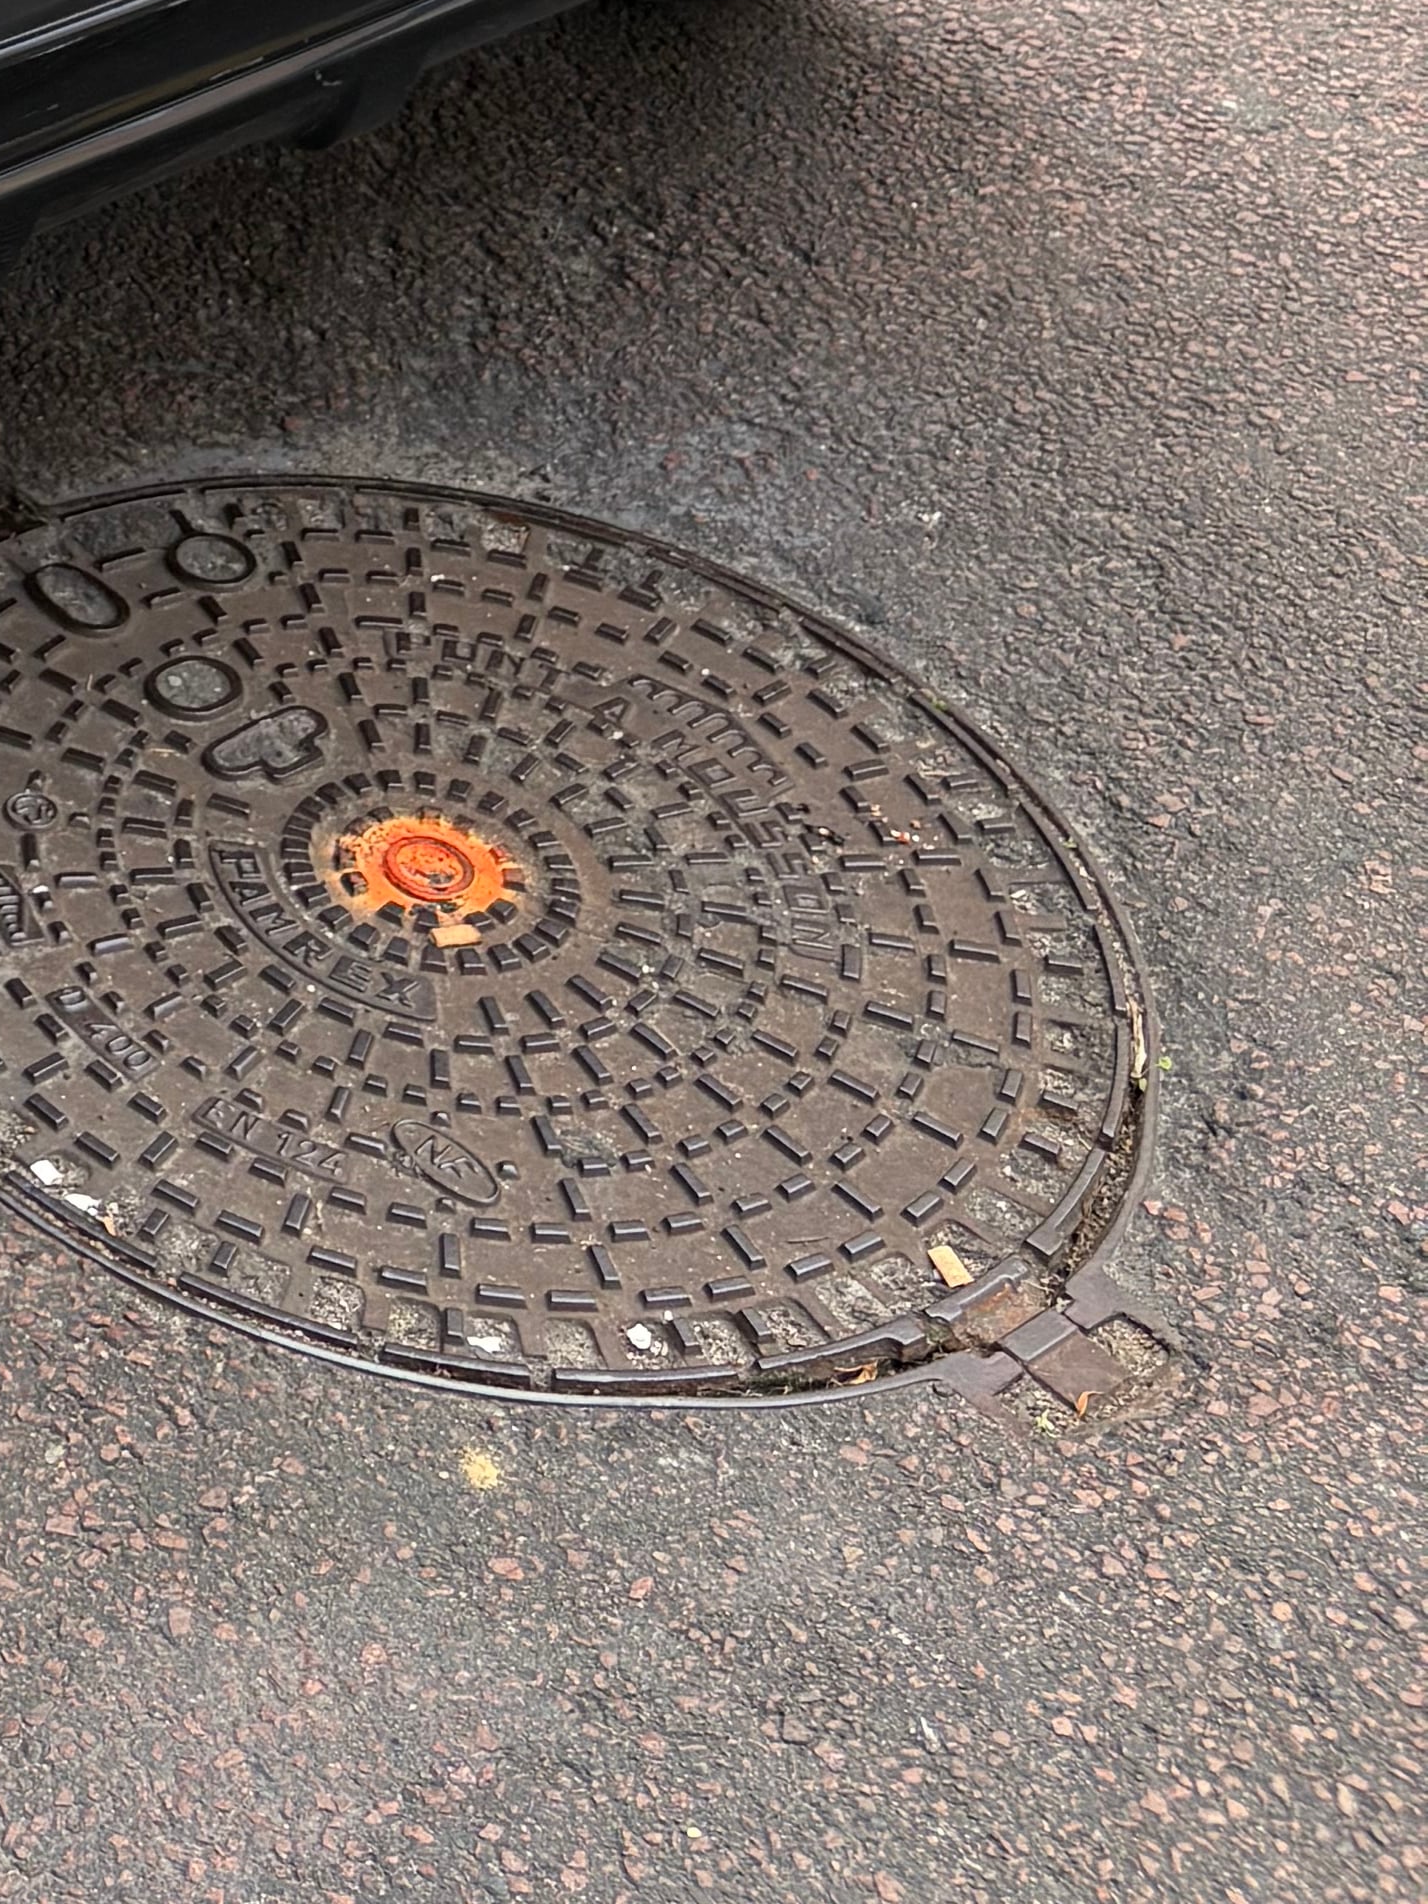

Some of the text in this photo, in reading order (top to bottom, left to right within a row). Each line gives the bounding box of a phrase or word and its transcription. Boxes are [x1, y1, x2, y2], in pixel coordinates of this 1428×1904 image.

[219, 849, 420, 1009] PAMREX
[85, 1020, 153, 1072] 400
[206, 1098, 345, 1178] EN 124
